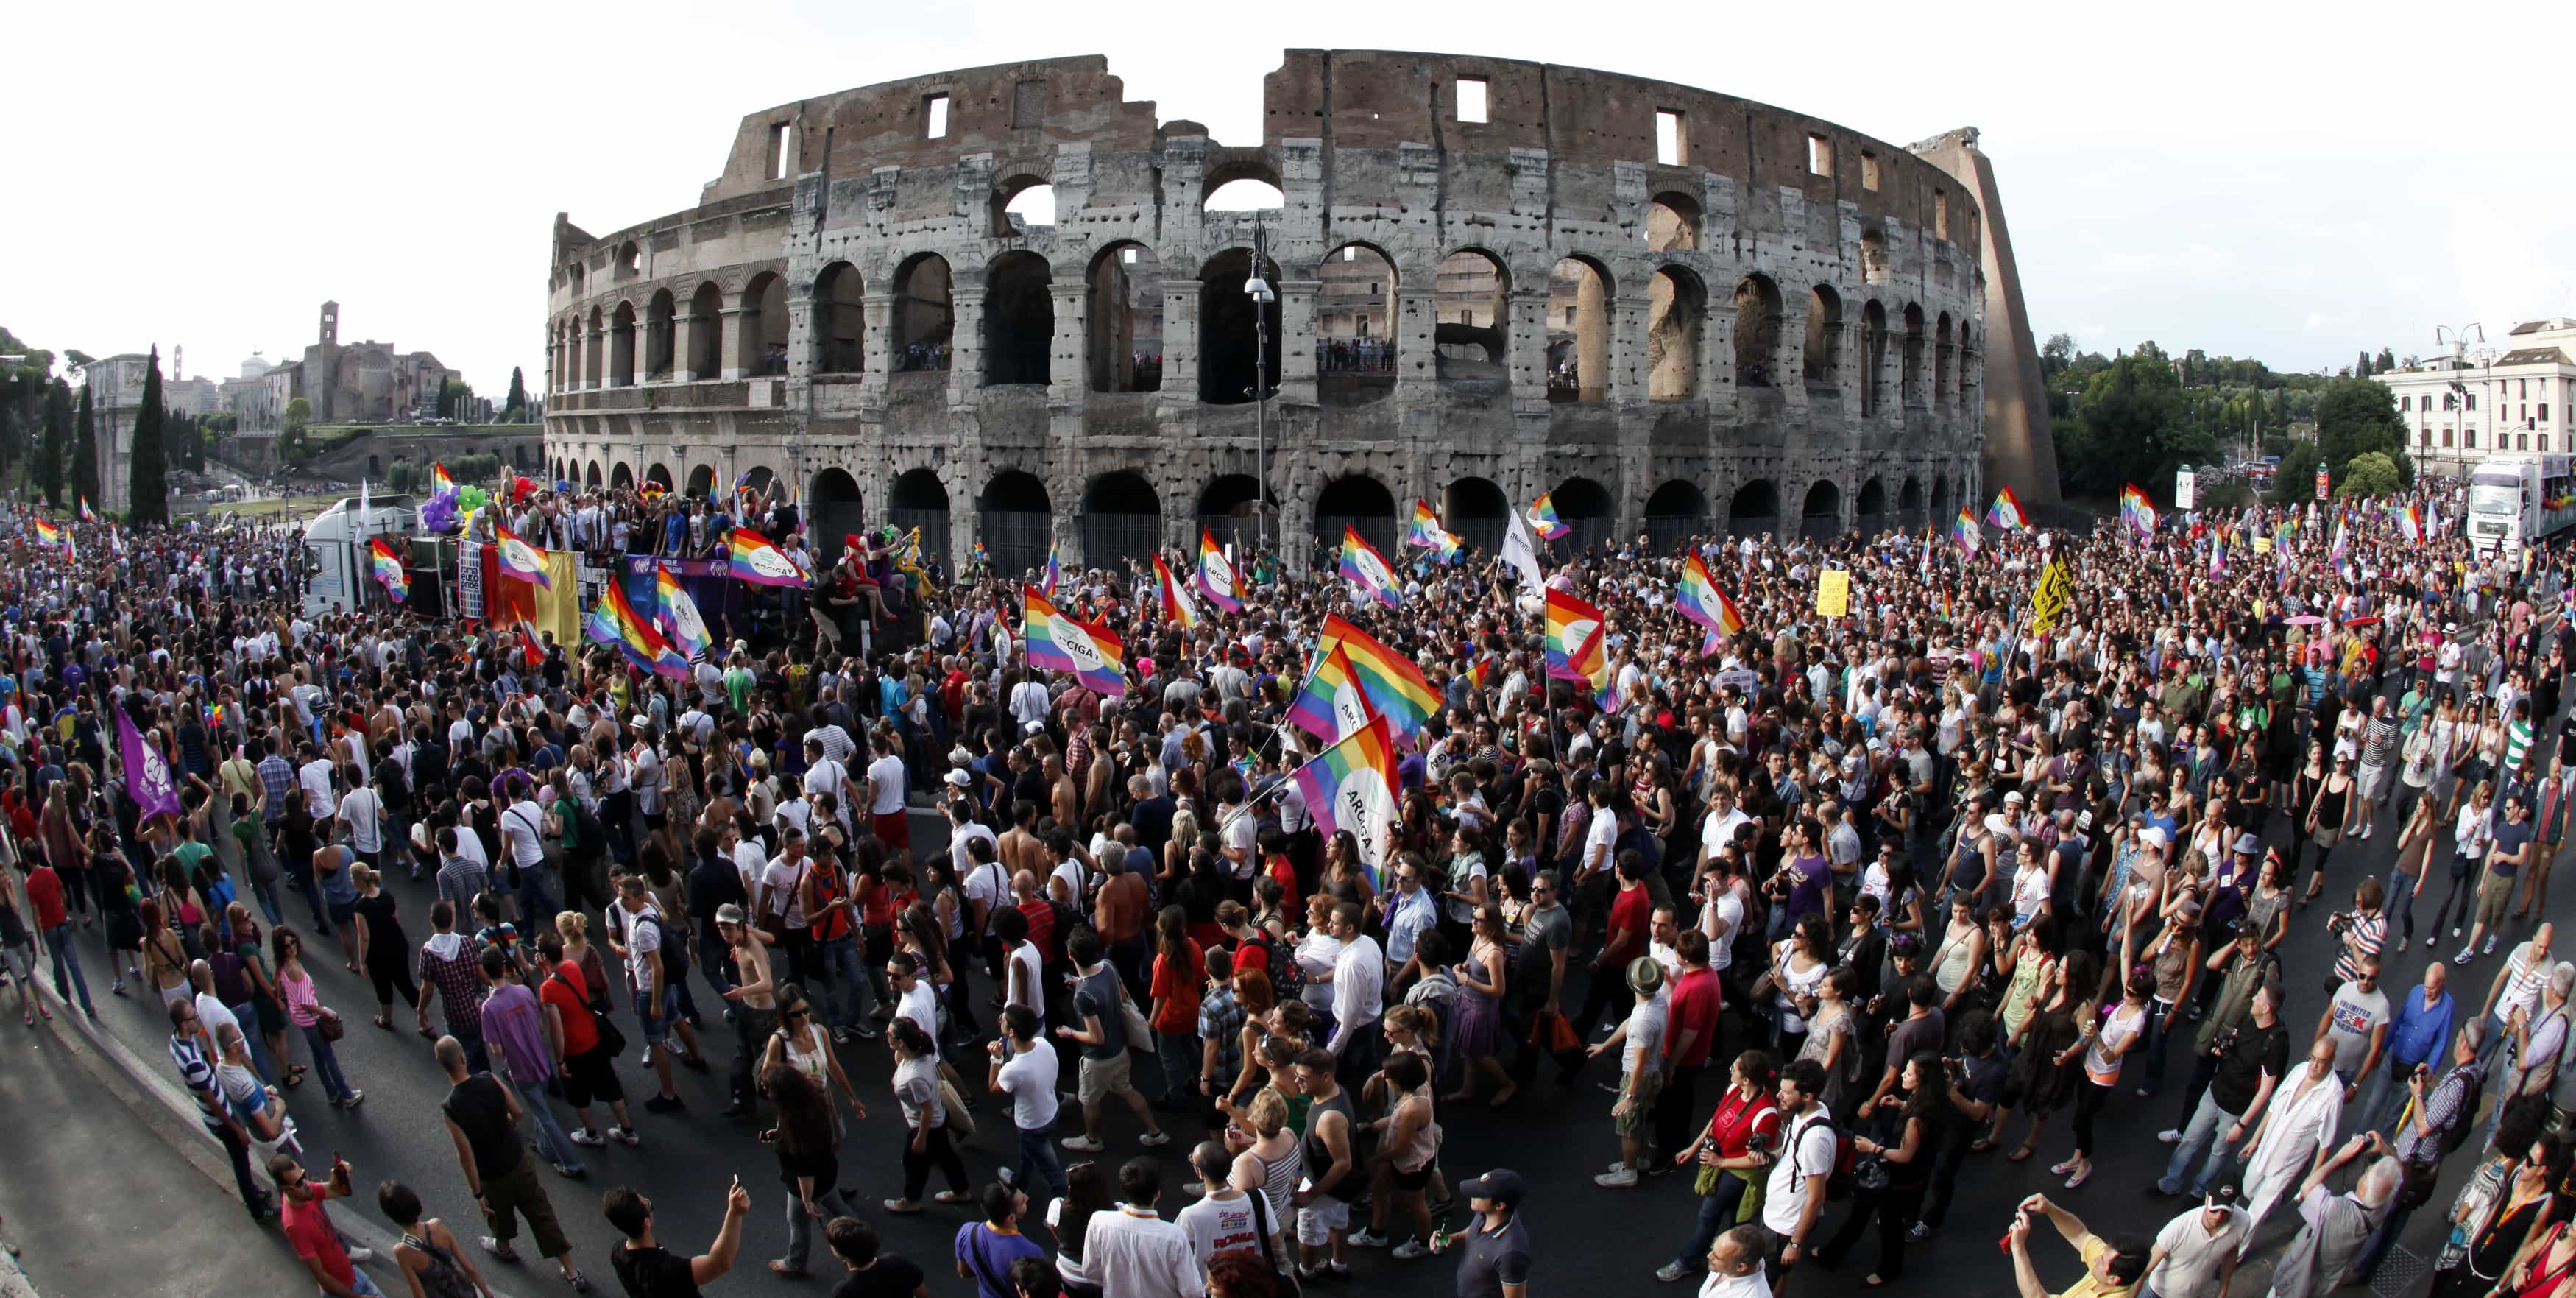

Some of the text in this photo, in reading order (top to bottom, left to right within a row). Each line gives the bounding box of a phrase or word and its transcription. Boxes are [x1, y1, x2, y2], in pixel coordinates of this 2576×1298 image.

[461, 566, 478, 574] roma
[461, 574, 479, 582] euro
[461, 582, 480, 591] pride
[1346, 790, 1376, 856] ARCIGAY
[1213, 1231, 1254, 1249] ROMA
